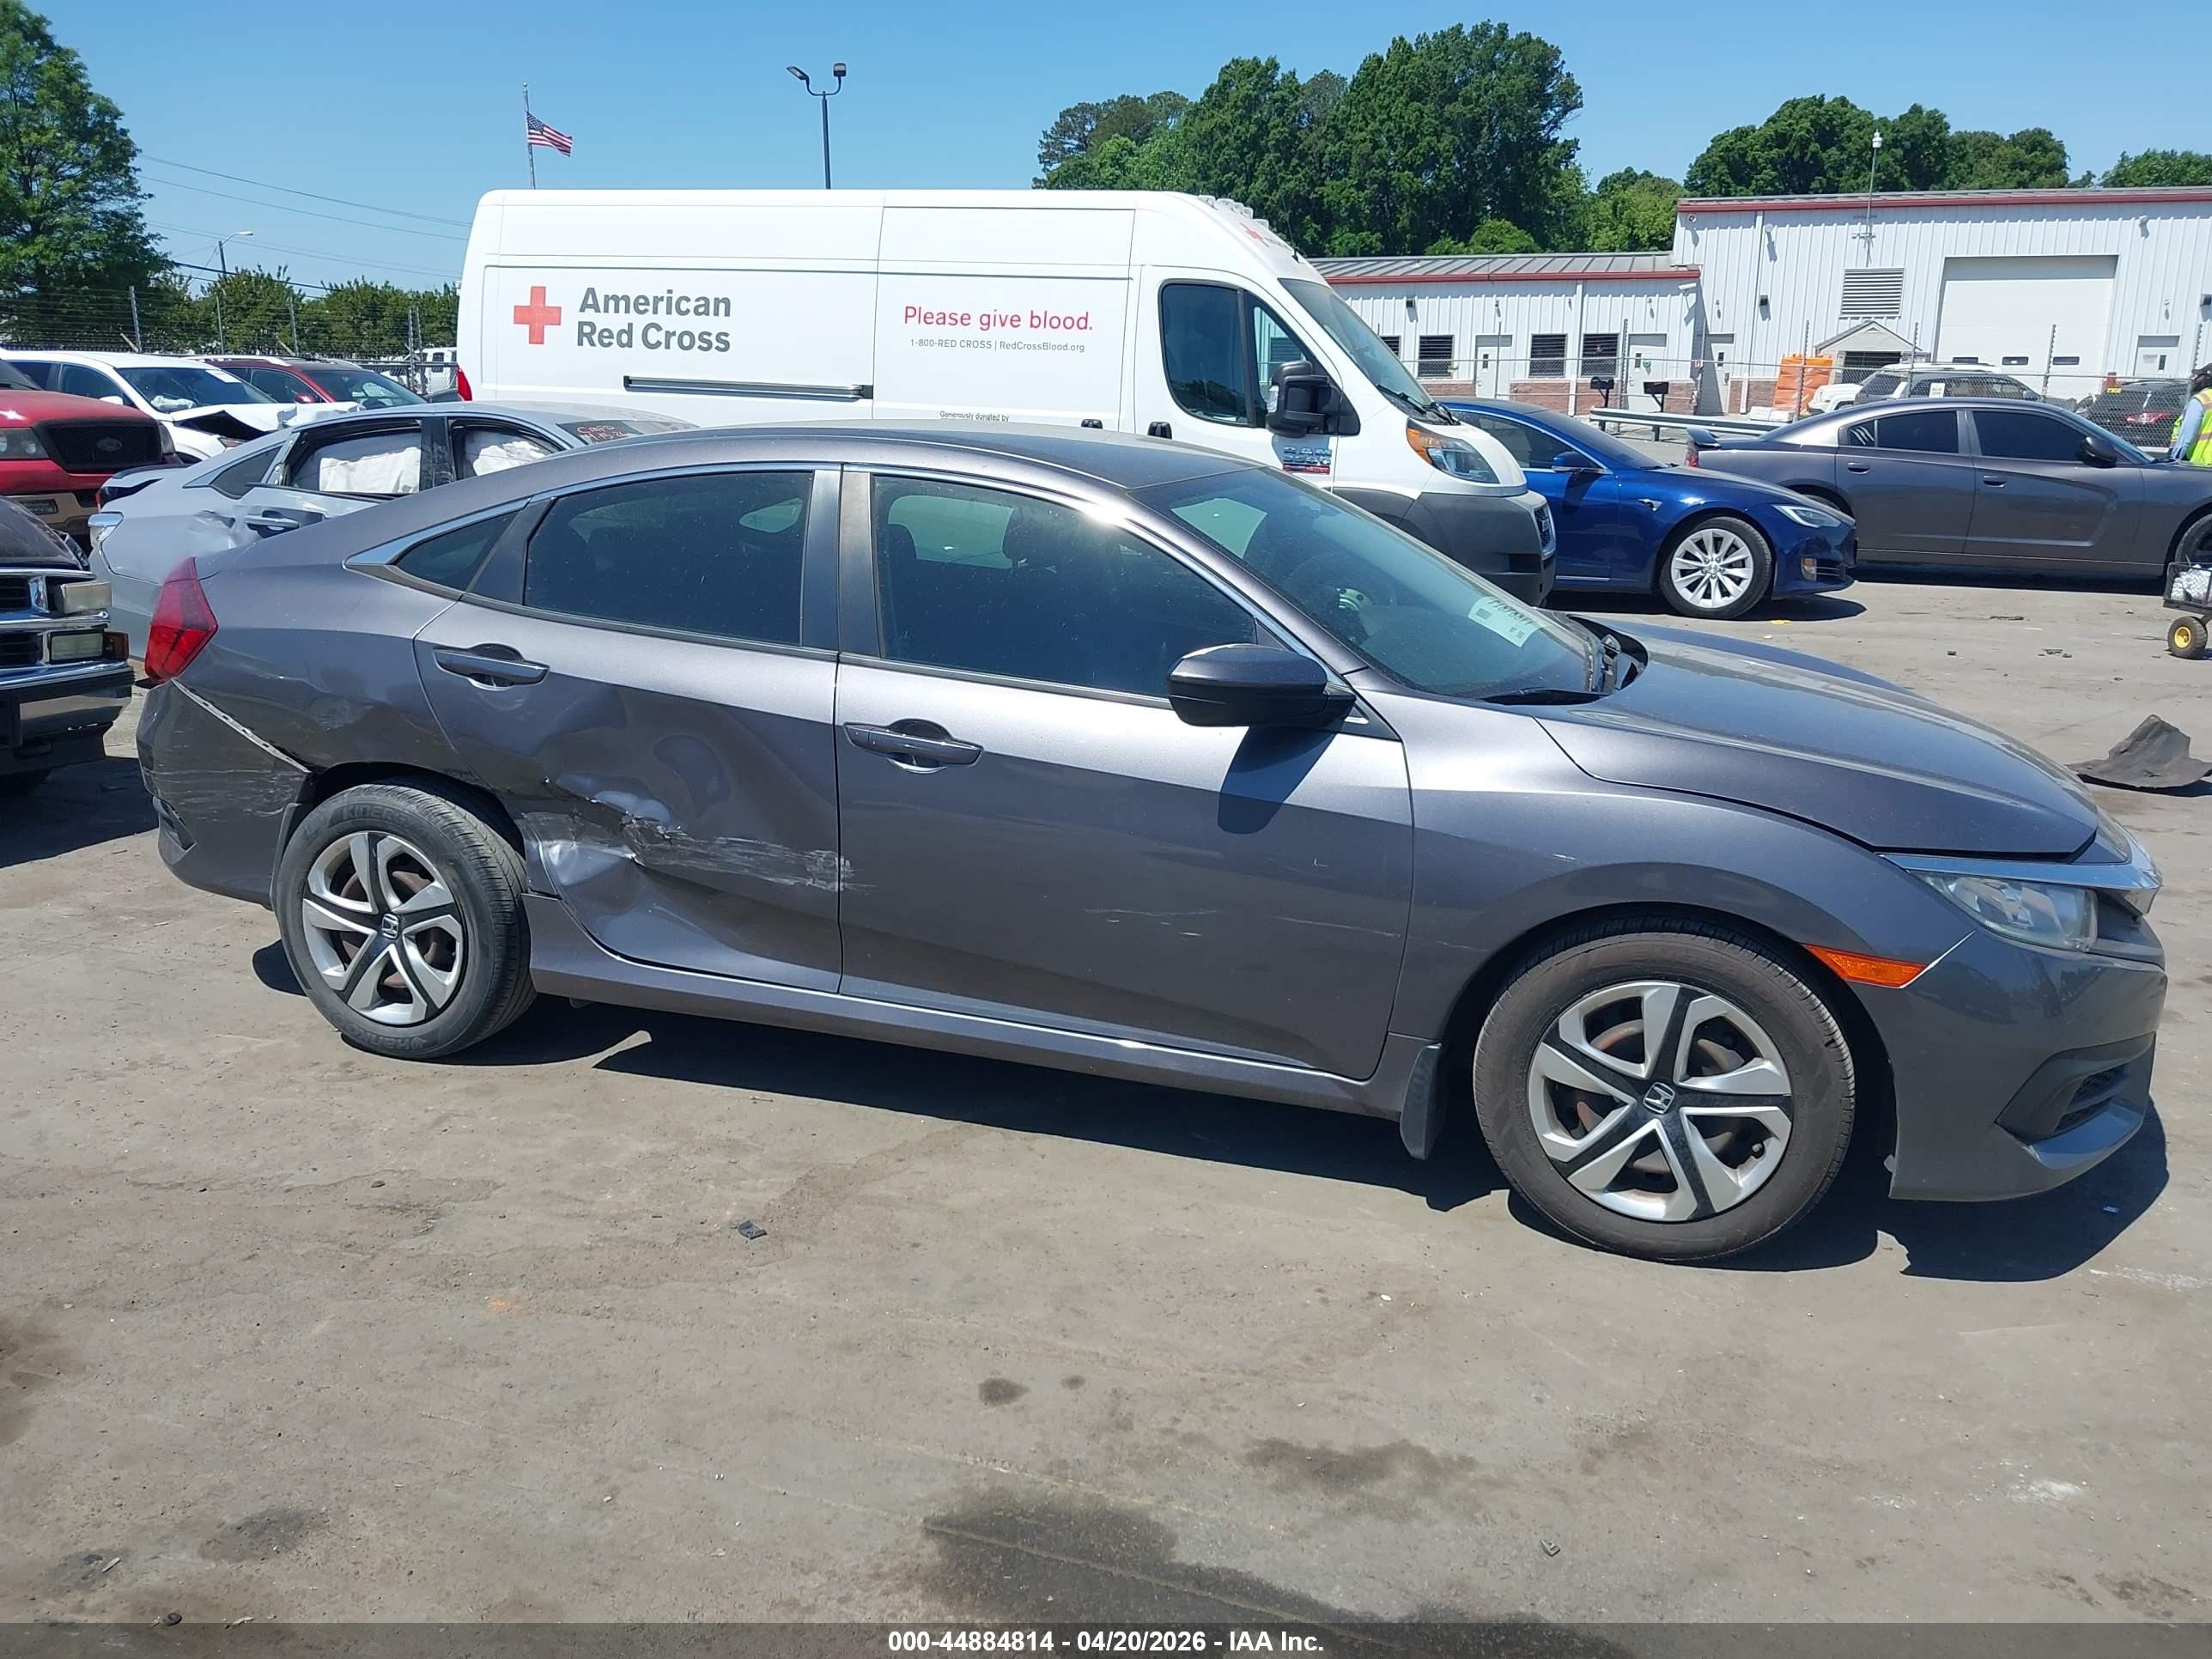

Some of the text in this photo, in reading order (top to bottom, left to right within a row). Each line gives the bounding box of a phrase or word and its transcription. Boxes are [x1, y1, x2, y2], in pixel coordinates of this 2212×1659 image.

[579, 287, 731, 317] American
[904, 306, 1094, 331] Please give blood.
[577, 321, 731, 353] Red Cross
[910, 337, 957, 349] 1-800-RED
[959, 339, 993, 349] CROSS
[999, 340, 1085, 353] RedCrossBlood.org
[939, 410, 1010, 422] Generously donated by
